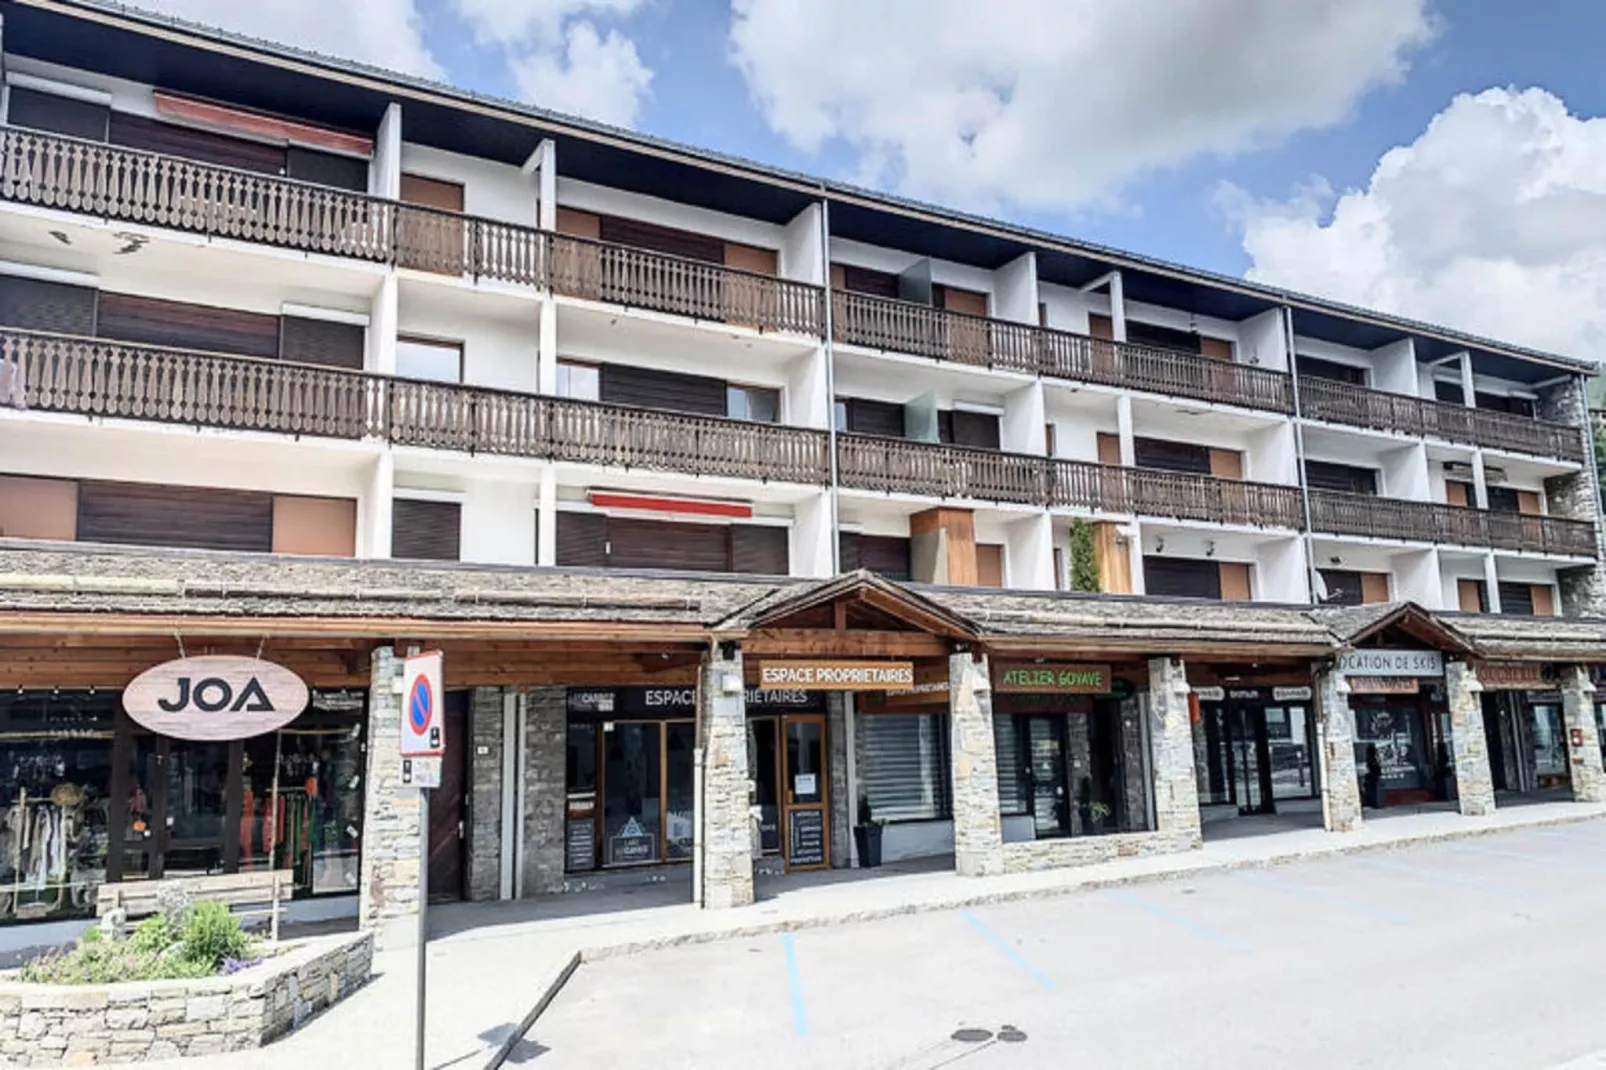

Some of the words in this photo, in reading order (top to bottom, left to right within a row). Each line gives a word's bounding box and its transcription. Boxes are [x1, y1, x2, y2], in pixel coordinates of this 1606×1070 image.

[1340, 654, 1391, 670] OCATION
[1394, 656, 1409, 670] DE
[1412, 655, 1437, 670] SKIS
[762, 667, 813, 683] ESPACE
[816, 667, 914, 684] PROPRIETAIRES
[1002, 670, 1055, 686] ATELIER
[1058, 670, 1103, 687] GOYAVE
[157, 676, 276, 712] JOA
